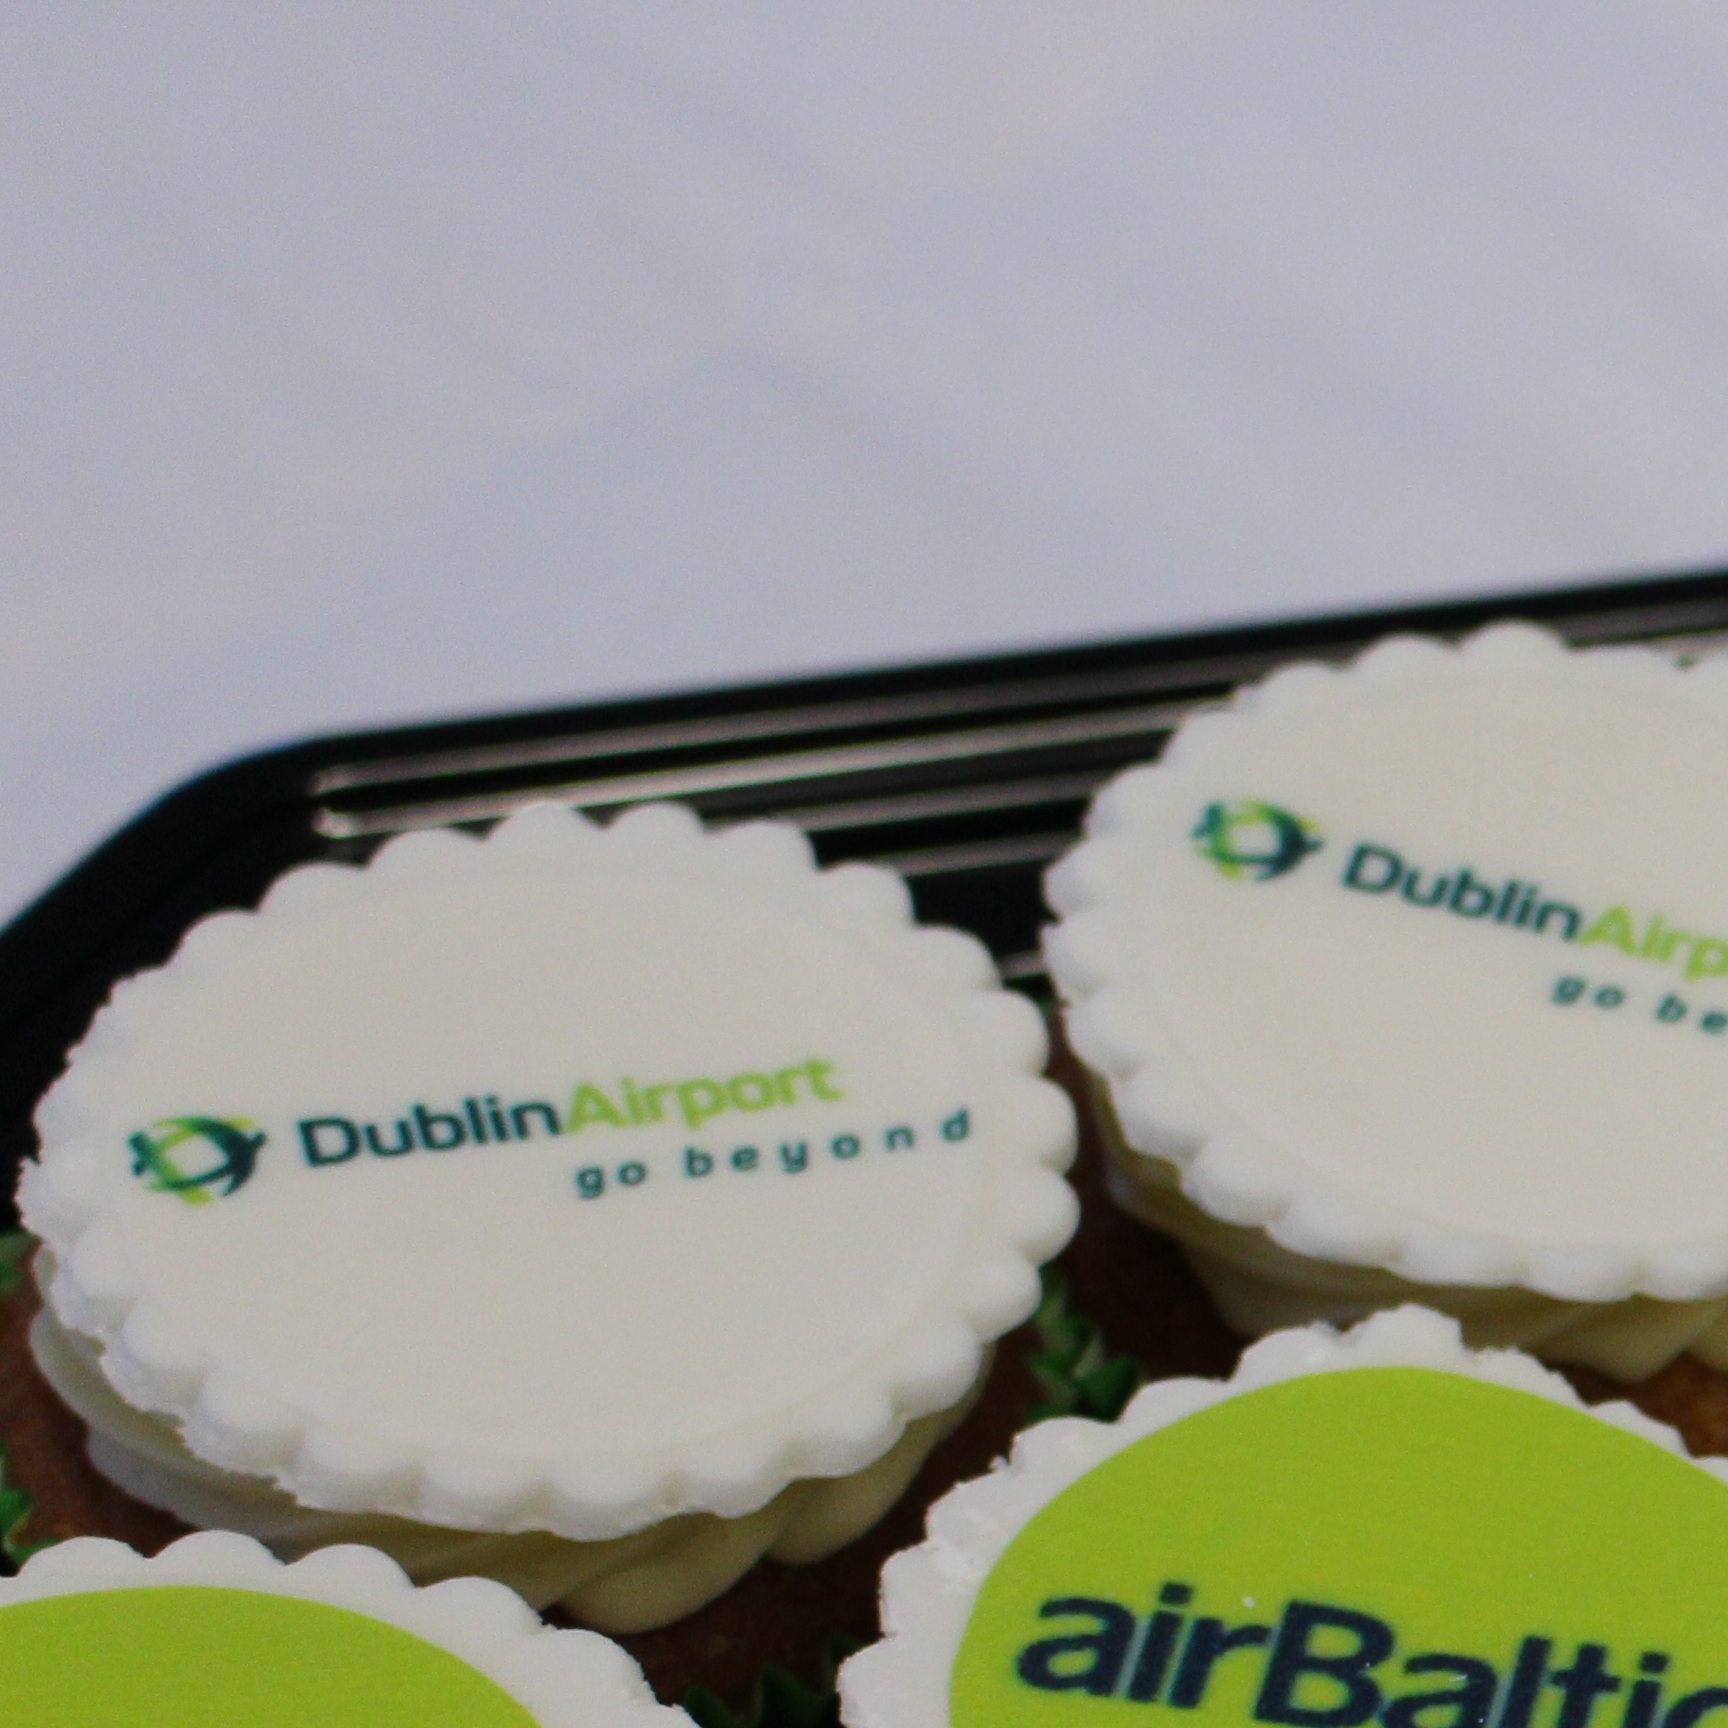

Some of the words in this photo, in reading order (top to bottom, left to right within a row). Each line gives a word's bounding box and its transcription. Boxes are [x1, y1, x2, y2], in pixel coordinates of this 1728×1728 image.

[1550, 976, 1627, 1009] go
[294, 1057, 846, 1169] DublinAirport
[573, 1160, 648, 1200] go
[682, 1108, 970, 1180] beyond
